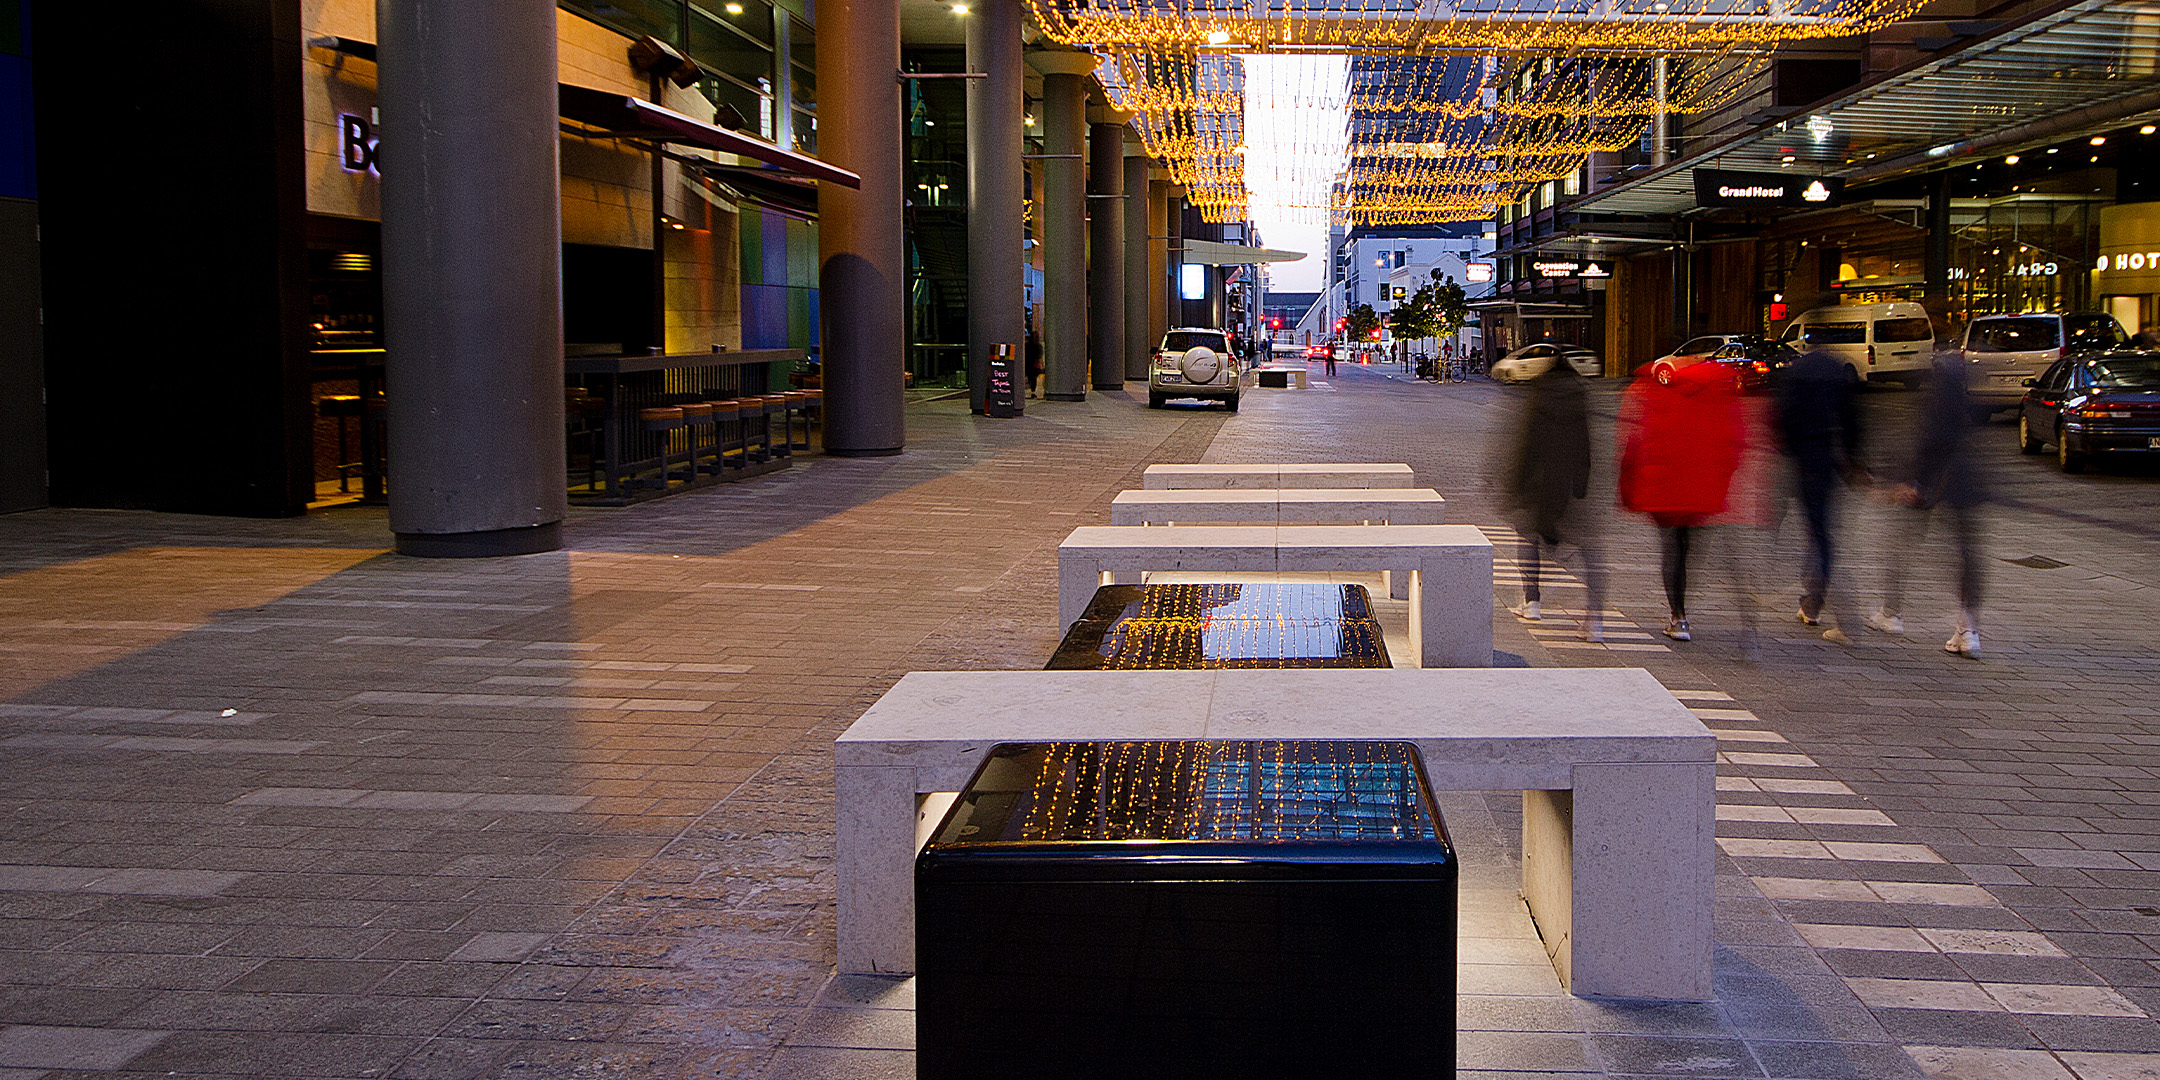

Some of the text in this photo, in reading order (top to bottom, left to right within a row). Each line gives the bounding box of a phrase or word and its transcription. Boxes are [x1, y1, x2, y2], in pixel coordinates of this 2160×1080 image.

[1719, 186, 1783, 198] Grand Hotel
[1533, 261, 1578, 271] Convention
[2115, 252, 2160, 270] HOT
[1542, 269, 1570, 277] Centre
